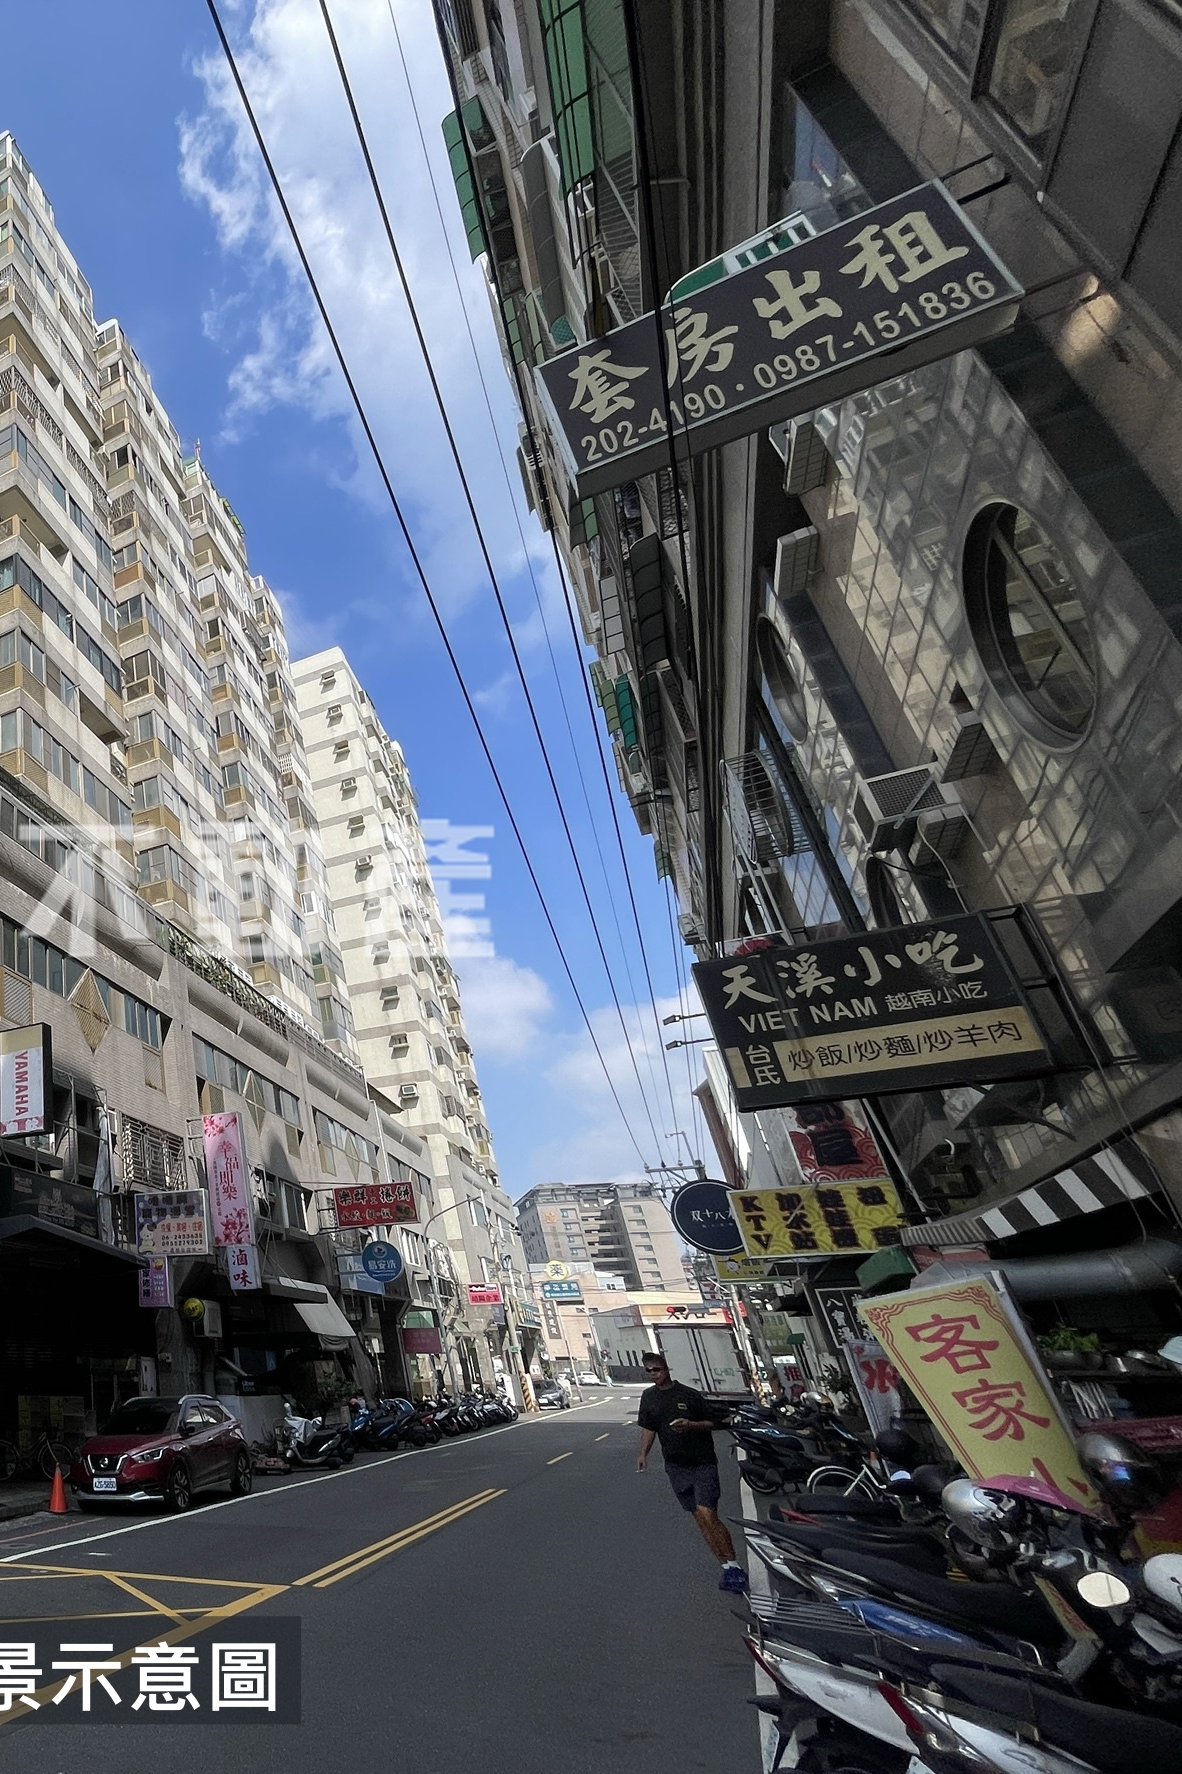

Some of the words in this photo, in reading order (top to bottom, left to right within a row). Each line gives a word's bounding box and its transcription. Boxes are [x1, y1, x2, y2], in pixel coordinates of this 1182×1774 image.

[566, 209, 970, 426] 套房出租
[723, 930, 985, 1011] 天溪小吃
[737, 1007, 801, 1035] VIET
[811, 996, 878, 1026] NAM
[884, 979, 988, 1015] 越南小吃
[14, 1050, 30, 1117] YAMAHA
[738, 1194, 773, 1251] KTV
[231, 1249, 253, 1288] 滷味
